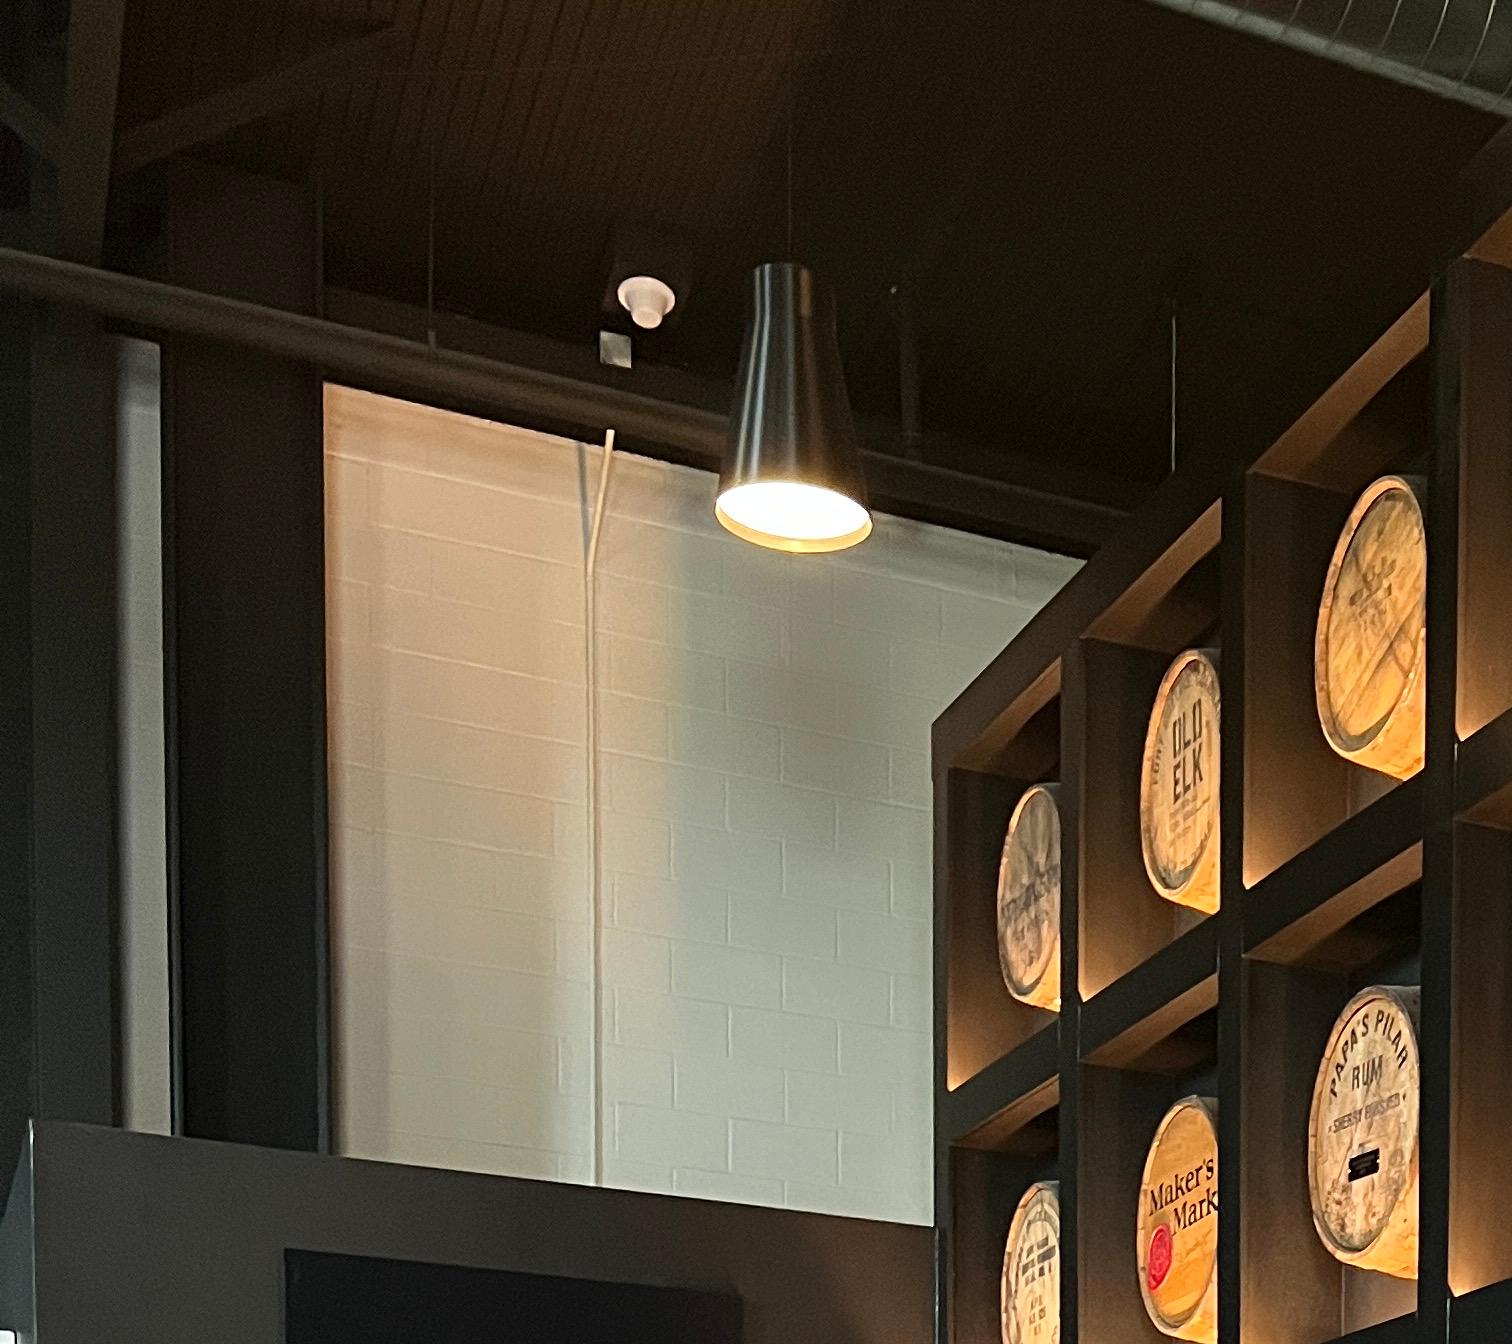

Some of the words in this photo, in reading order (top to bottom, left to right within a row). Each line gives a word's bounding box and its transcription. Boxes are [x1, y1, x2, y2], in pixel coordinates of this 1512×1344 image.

[1173, 697, 1202, 760] OLD
[1173, 741, 1203, 804] ELK
[1331, 1012, 1370, 1098] PAPA'S
[1374, 1009, 1409, 1070] PILAR
[1352, 1054, 1384, 1091] RUM
[1149, 1158, 1214, 1216] Maker's
[1171, 1188, 1218, 1237] Mark
